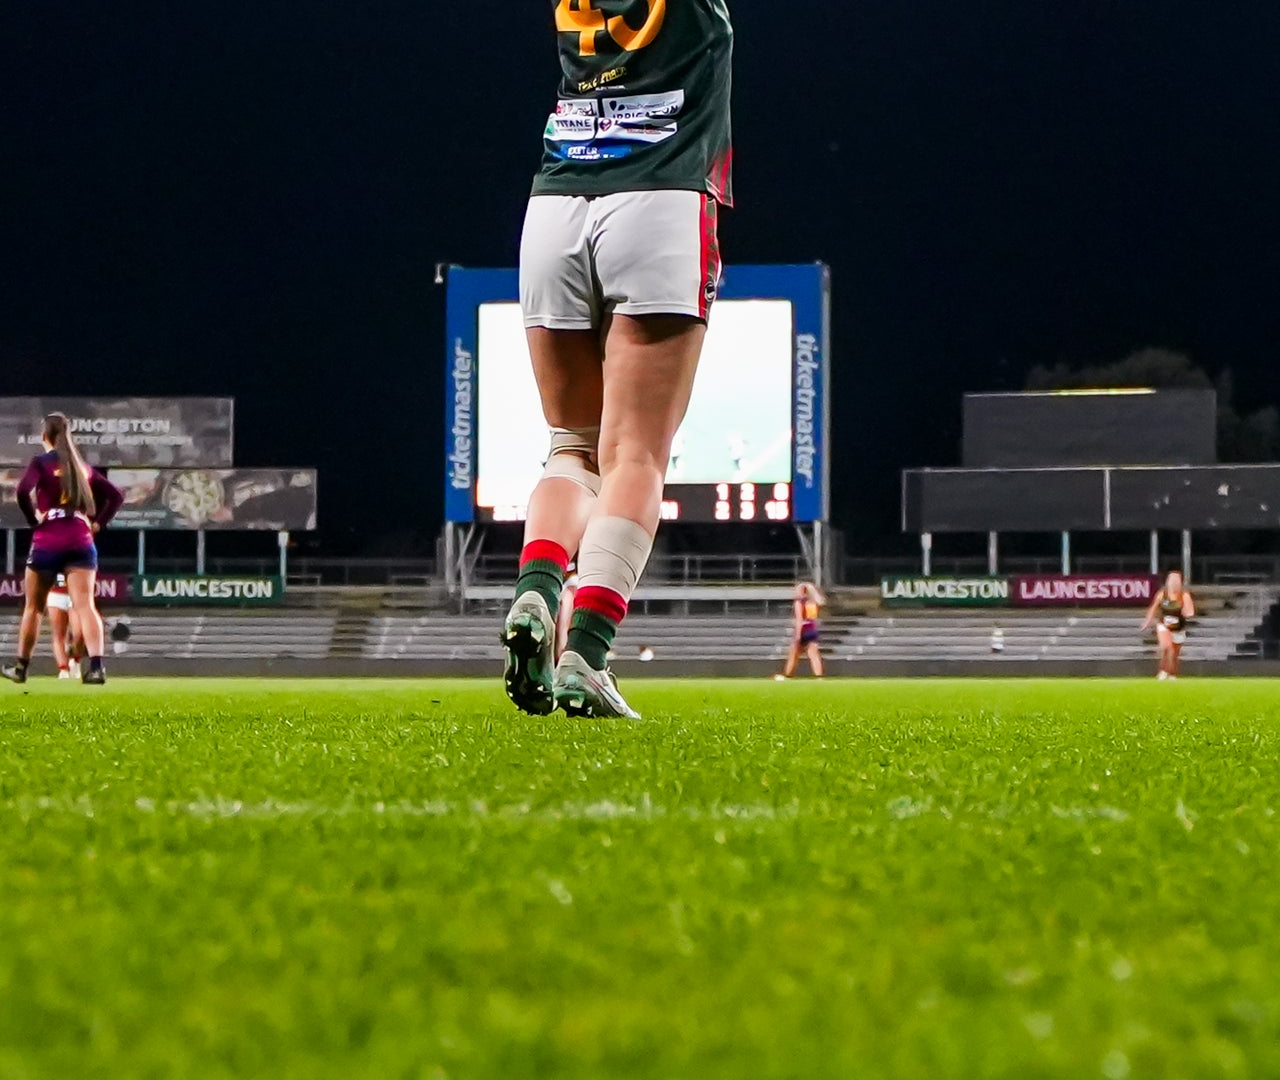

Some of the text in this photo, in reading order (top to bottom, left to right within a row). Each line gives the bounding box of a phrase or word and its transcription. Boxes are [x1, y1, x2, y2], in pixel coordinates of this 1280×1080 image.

[449, 337, 471, 489] ticketmaster
[796, 334, 819, 489] ticketmaster
[142, 579, 272, 598] LAUNCESTON
[881, 580, 1008, 598] LAUNCESTON
[1020, 580, 1150, 599] LAUNCESTON
